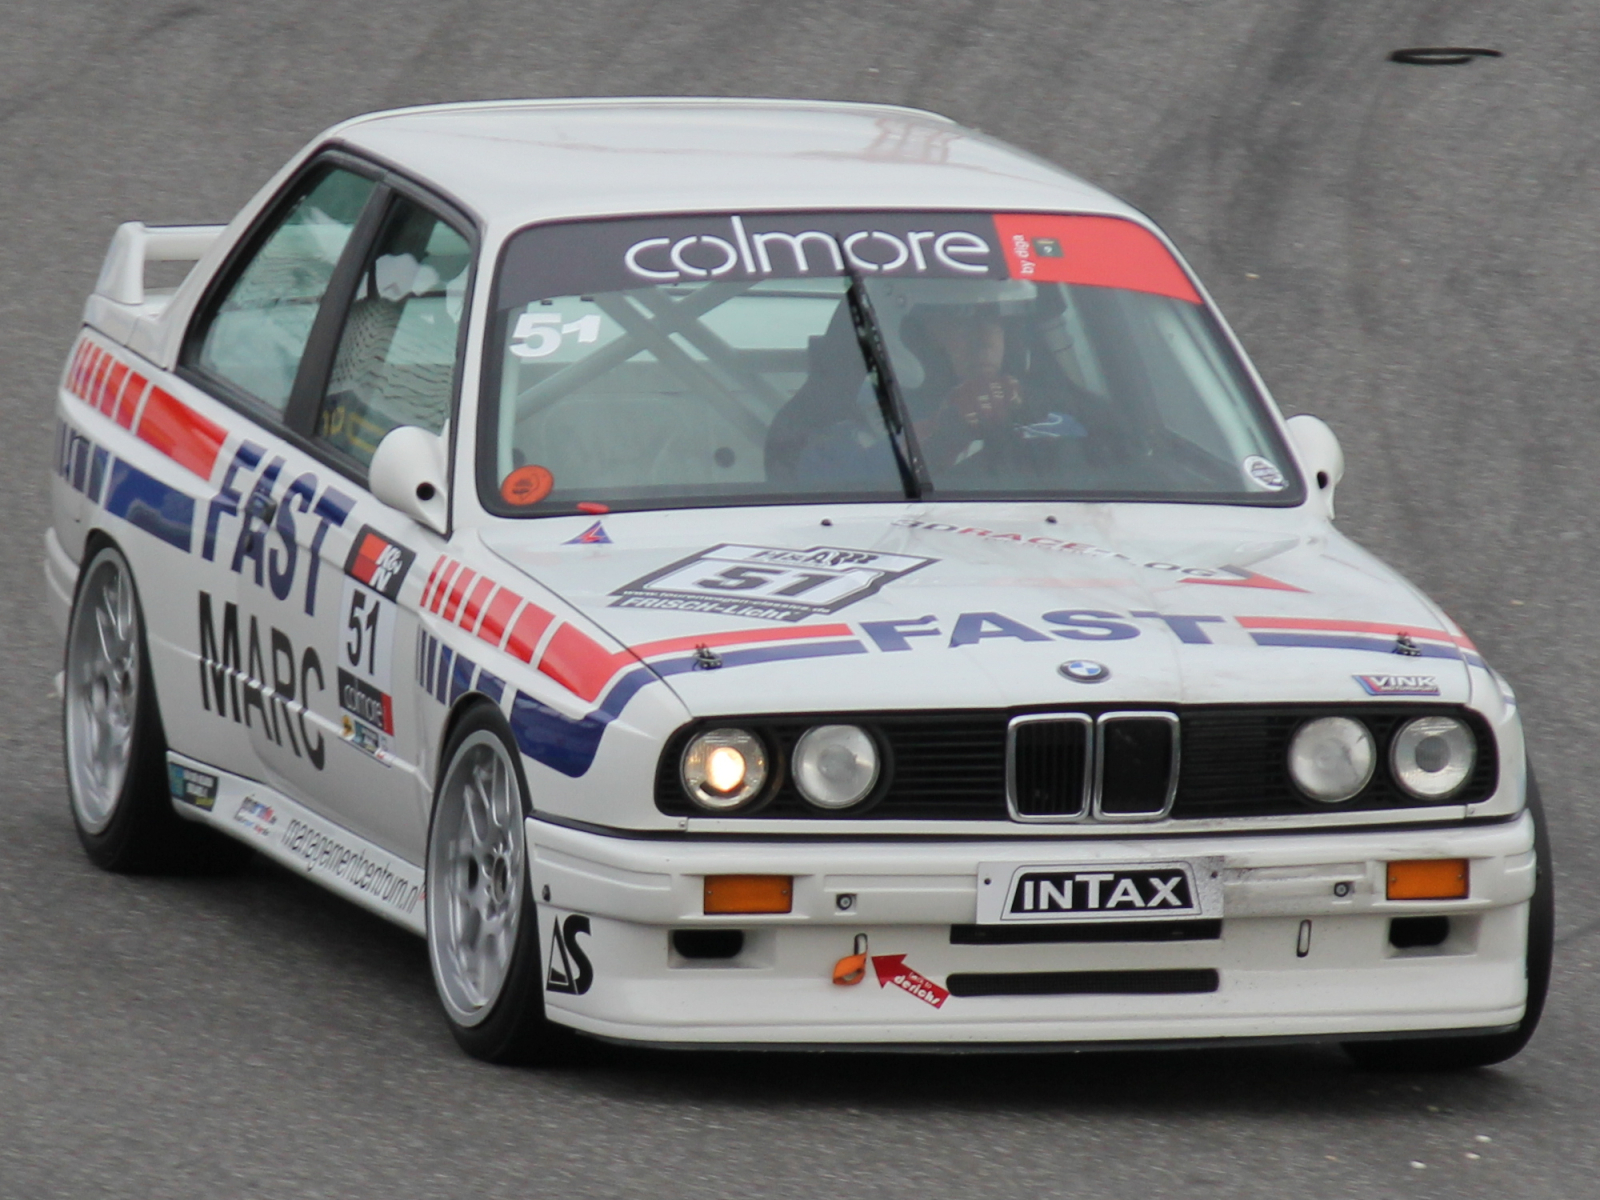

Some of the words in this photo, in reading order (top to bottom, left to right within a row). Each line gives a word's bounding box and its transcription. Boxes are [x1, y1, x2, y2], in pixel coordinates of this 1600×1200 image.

[625, 214, 991, 279] colmore
[1020, 260, 1037, 275] by
[508, 312, 602, 358] 51
[202, 438, 357, 617] FAST
[691, 565, 840, 598] 51
[346, 589, 381, 677] 51
[858, 609, 1227, 653] FAST
[198, 590, 325, 772] MARC
[1370, 676, 1436, 687] VINK
[1022, 872, 1183, 911] INTAX
